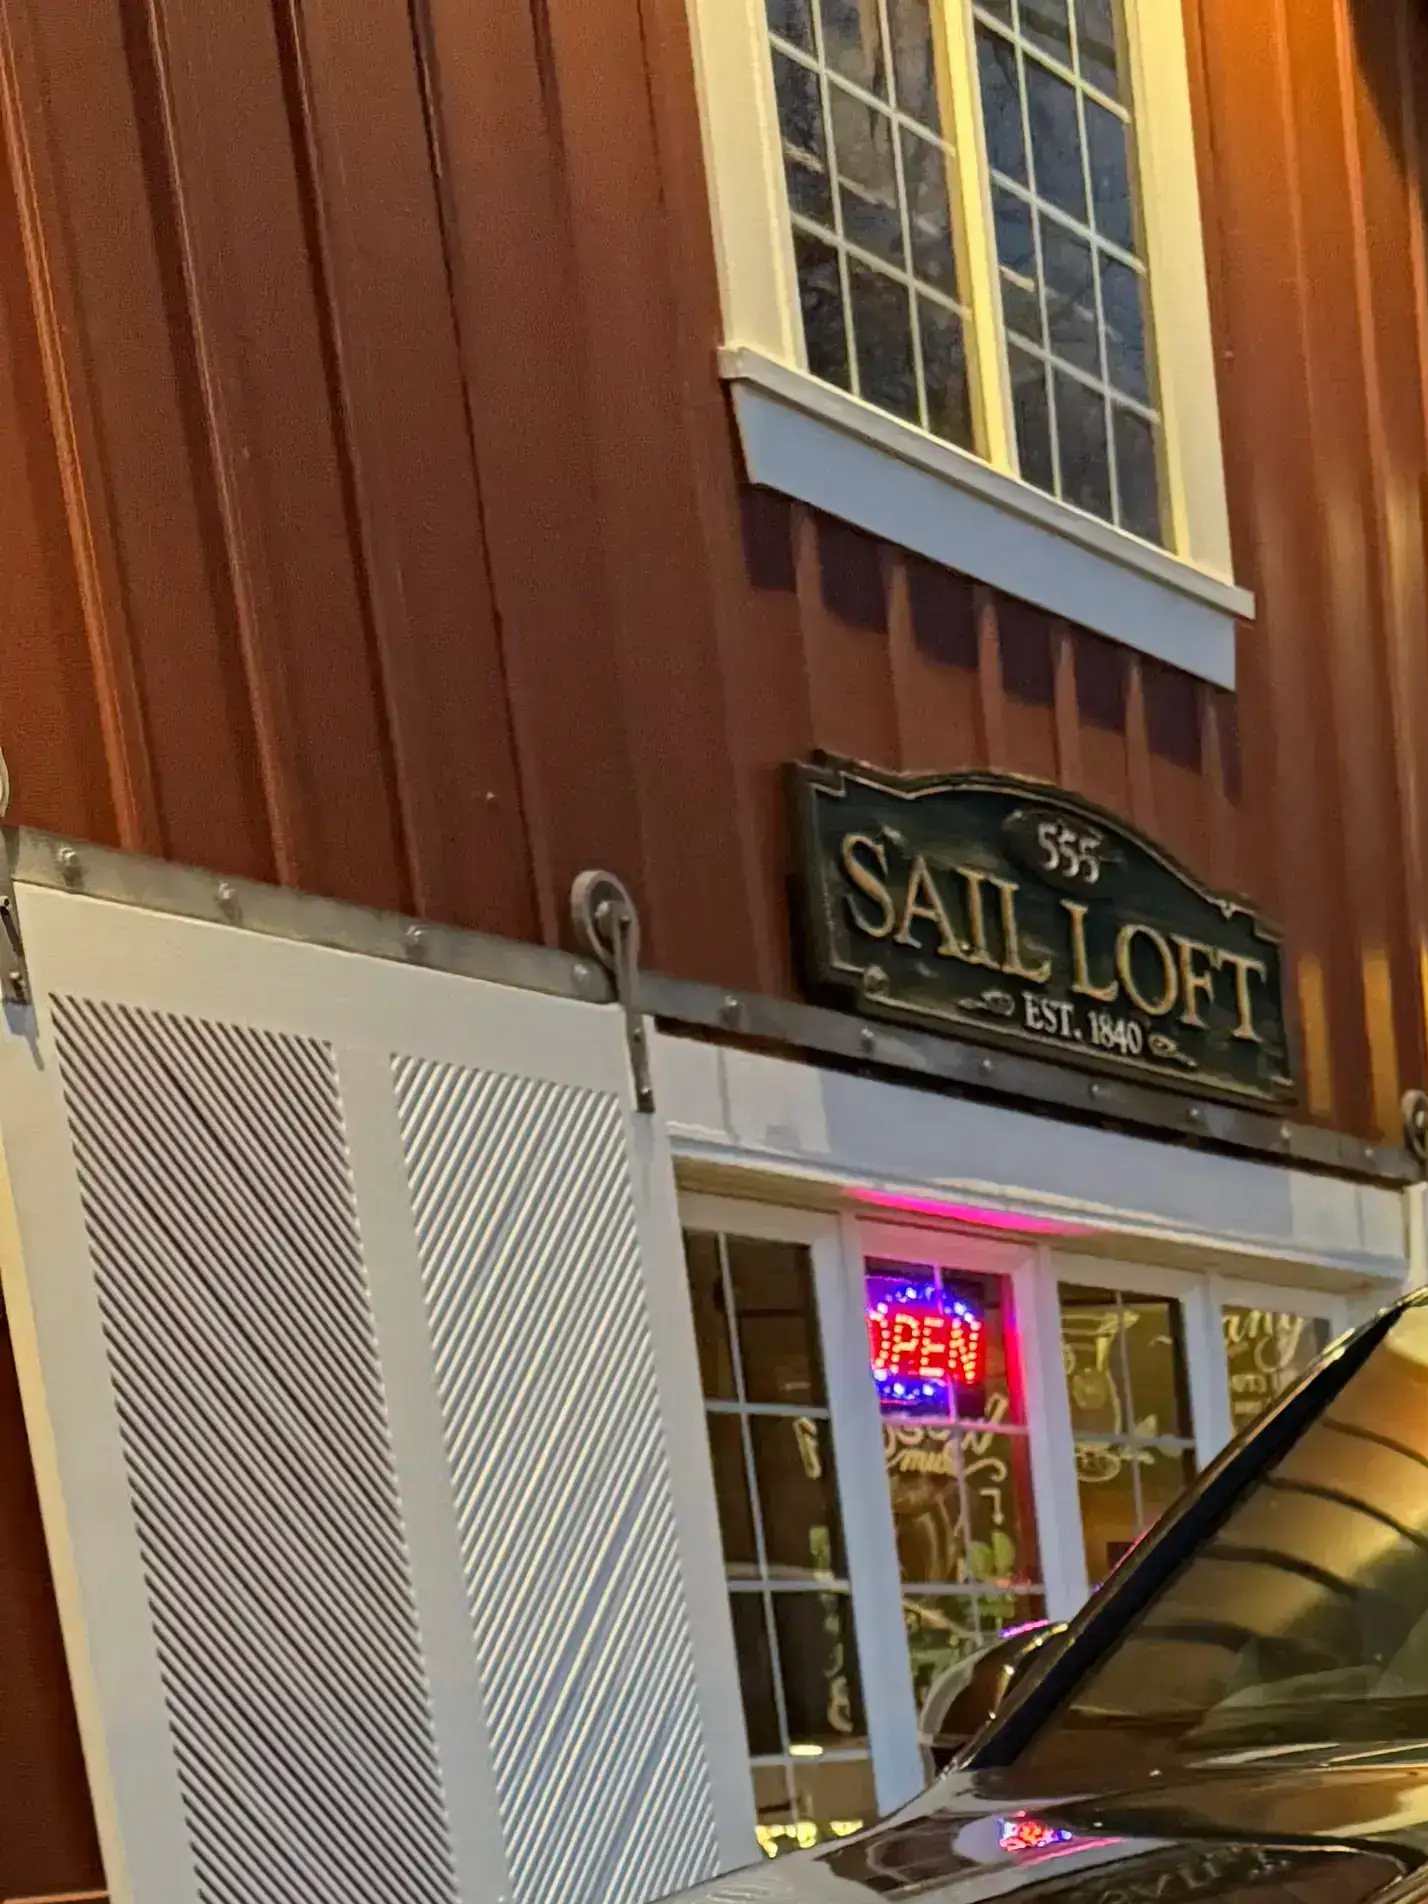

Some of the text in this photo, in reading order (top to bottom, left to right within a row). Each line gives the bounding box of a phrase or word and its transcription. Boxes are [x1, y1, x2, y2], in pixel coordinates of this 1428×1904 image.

[1038, 820, 1101, 884] 555
[841, 832, 1266, 1044] SAIL LOFT
[1021, 991, 1144, 1055] EST. 1840
